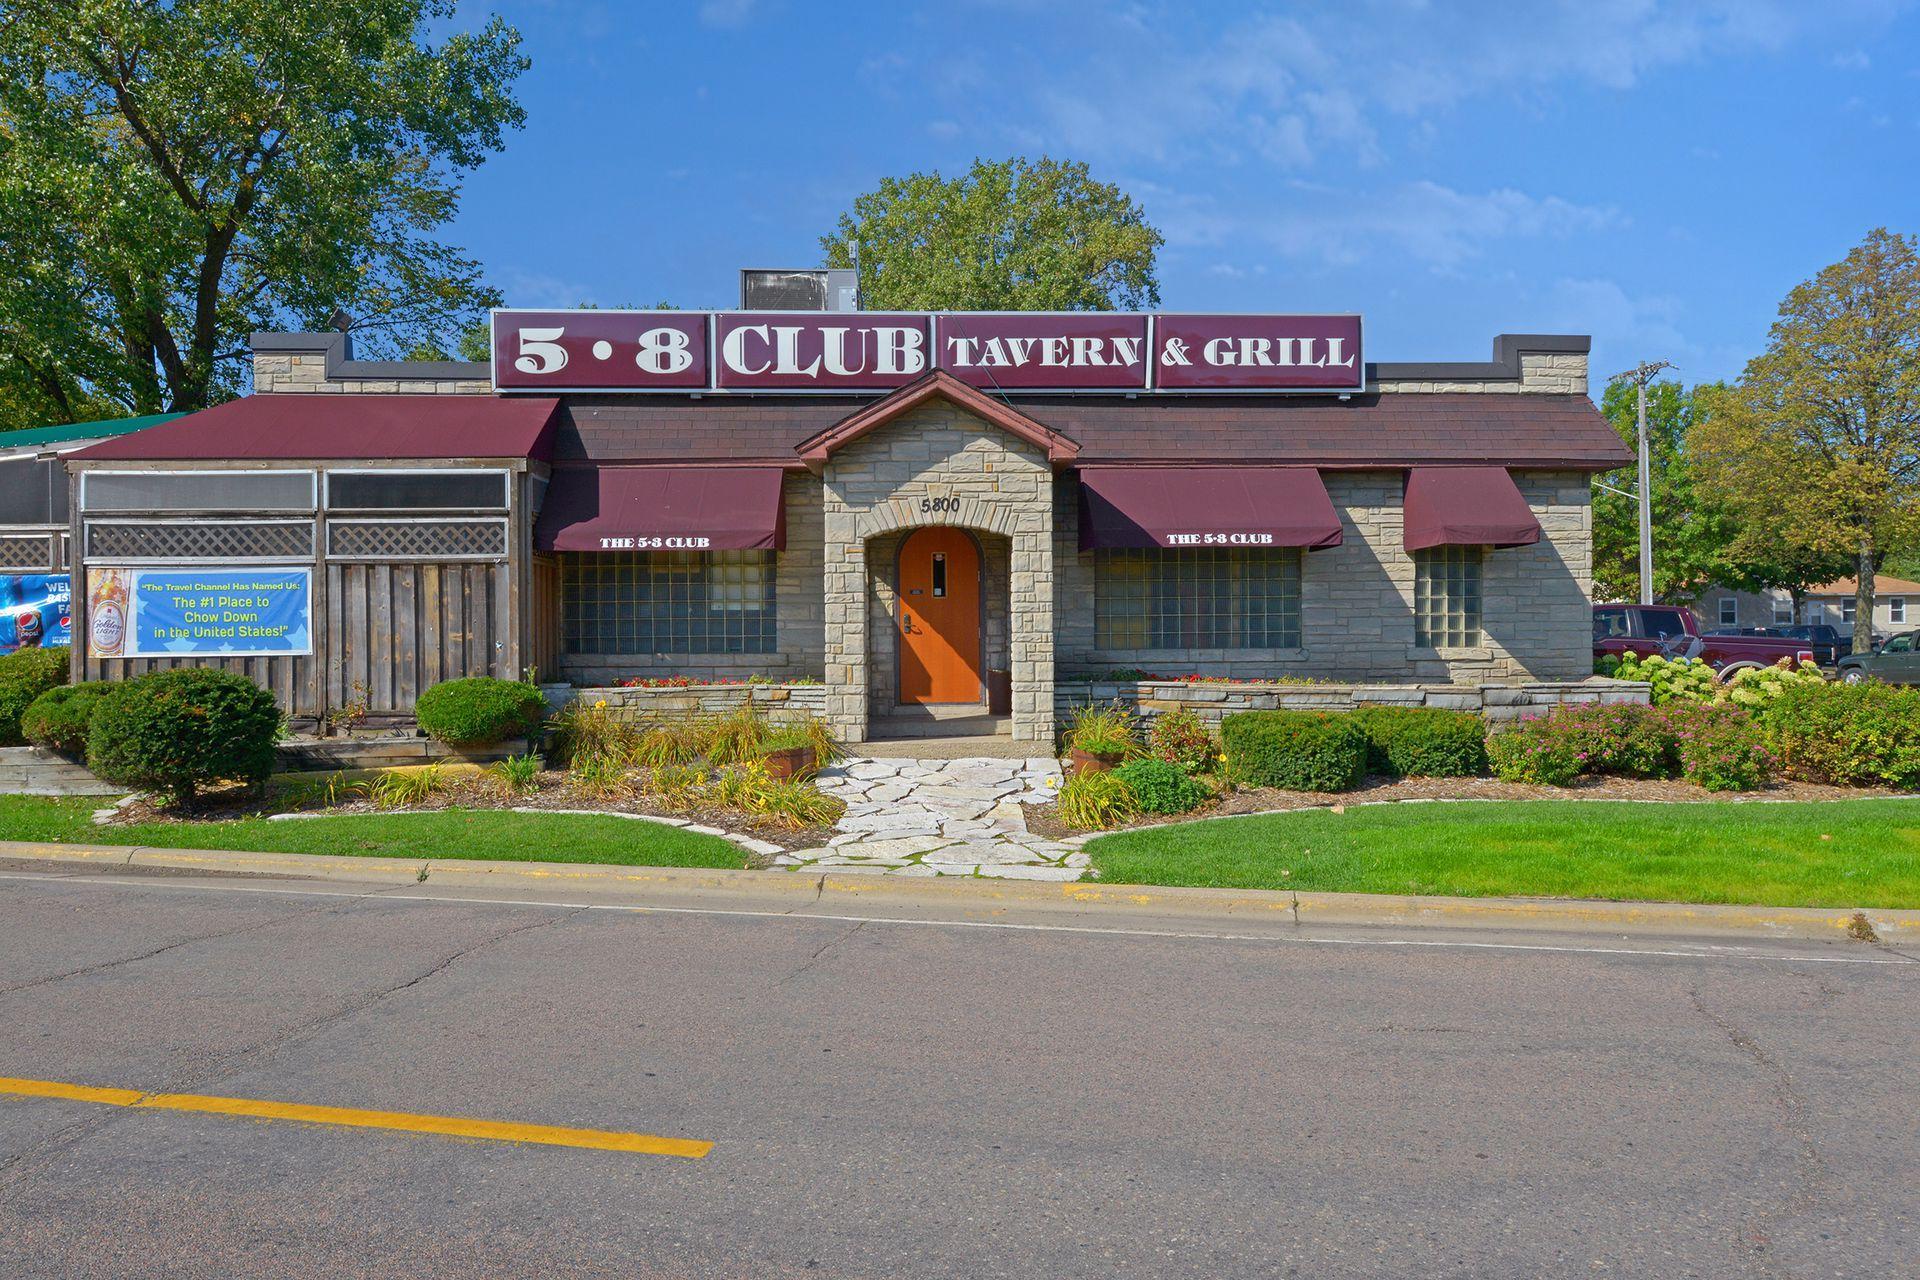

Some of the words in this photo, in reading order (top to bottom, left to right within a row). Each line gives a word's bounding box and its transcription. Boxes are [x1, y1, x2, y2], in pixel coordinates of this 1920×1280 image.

[722, 323, 926, 378] CLUB
[947, 336, 1143, 369] TAVERN
[1160, 337, 1194, 367] &
[1203, 336, 1356, 368] GRILL
[921, 497, 960, 513] 5800
[600, 537, 635, 548] THE
[665, 537, 710, 548] CLUB
[1166, 533, 1201, 545] THE
[1230, 533, 1273, 544] CLUB
[165, 583, 192, 591] Travel
[194, 583, 230, 591] Channel
[252, 582, 283, 590] Named
[285, 582, 301, 590] Us:
[172, 597, 196, 608] The
[200, 597, 214, 608] #1
[218, 596, 253, 608] Place
[257, 596, 269, 607] to
[184, 611, 219, 623] Chow
[223, 611, 258, 623] Down
[154, 626, 166, 638] in
[169, 626, 190, 638] the
[194, 626, 235, 637] United
